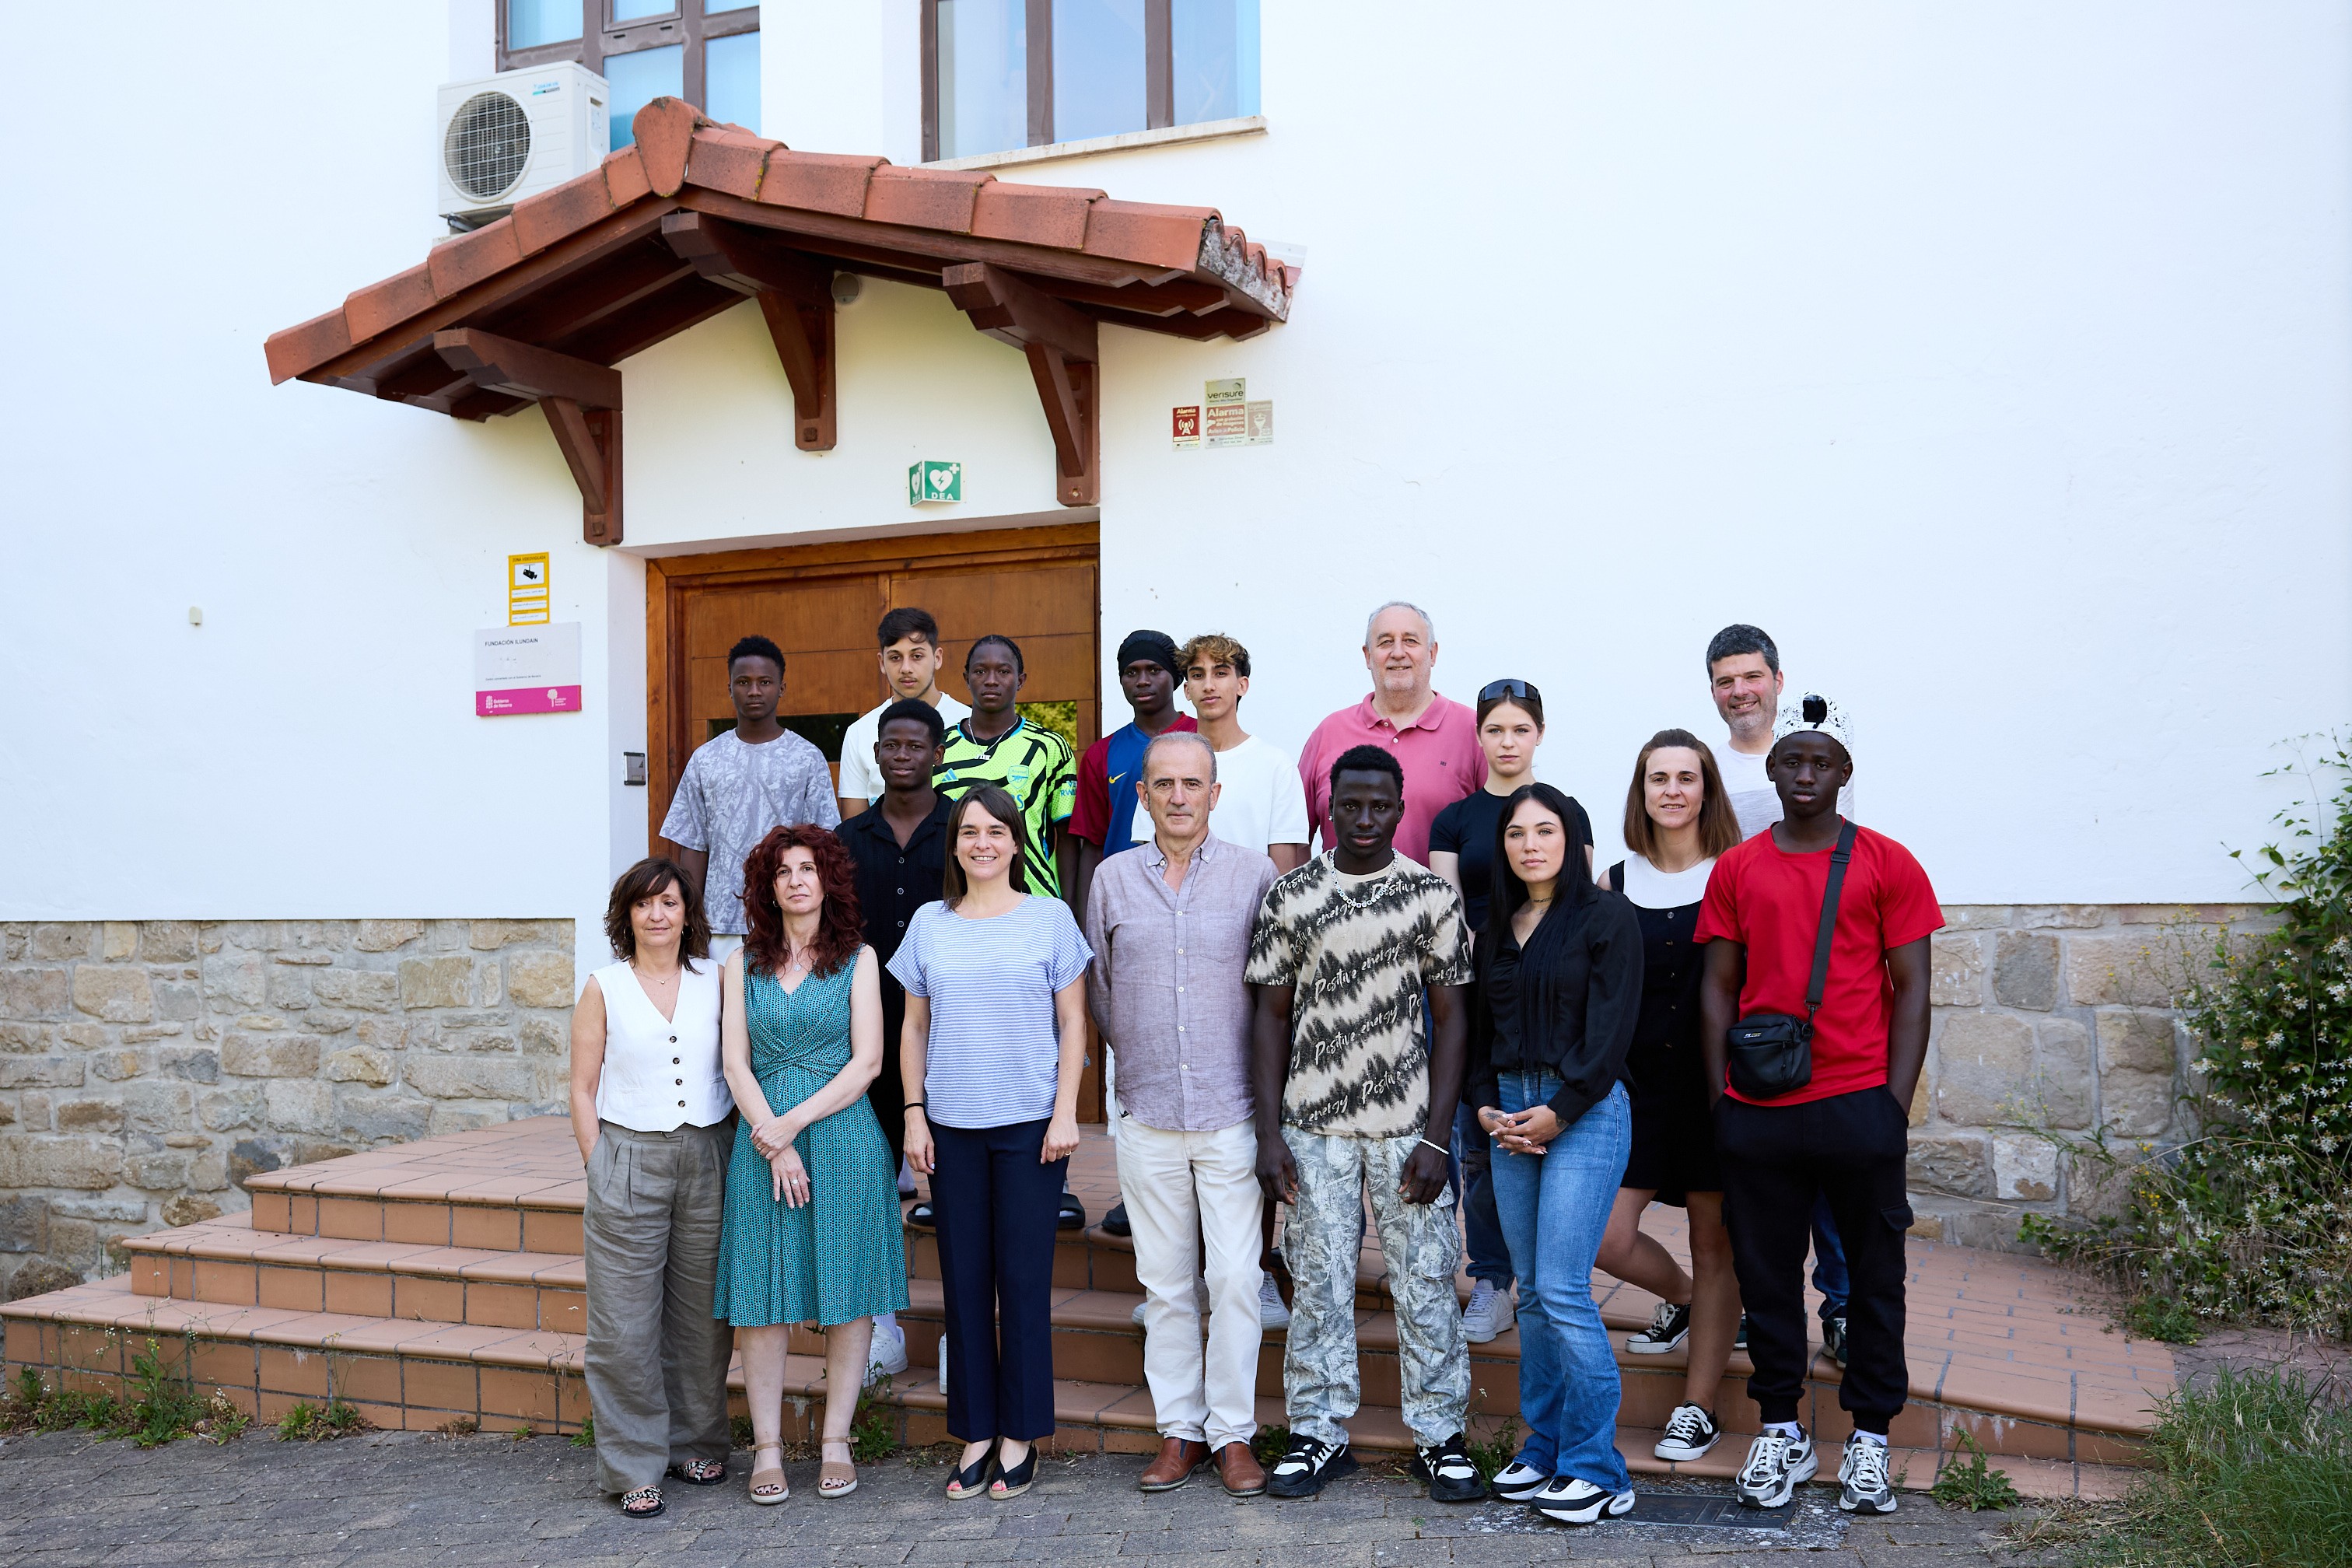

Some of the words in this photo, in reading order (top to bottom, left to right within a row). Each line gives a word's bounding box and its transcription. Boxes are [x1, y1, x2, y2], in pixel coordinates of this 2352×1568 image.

[1207, 390, 1244, 399] verisure
[1207, 408, 1244, 418] Alarma
[1277, 869, 1318, 903] Positive
[1314, 967, 1357, 1004] Positive
[1361, 942, 1400, 971] energy
[1315, 1031, 1356, 1066] Positive
[1361, 1004, 1398, 1034] energy
[1361, 1069, 1402, 1105] Positive
[1308, 1094, 1349, 1123] energy
